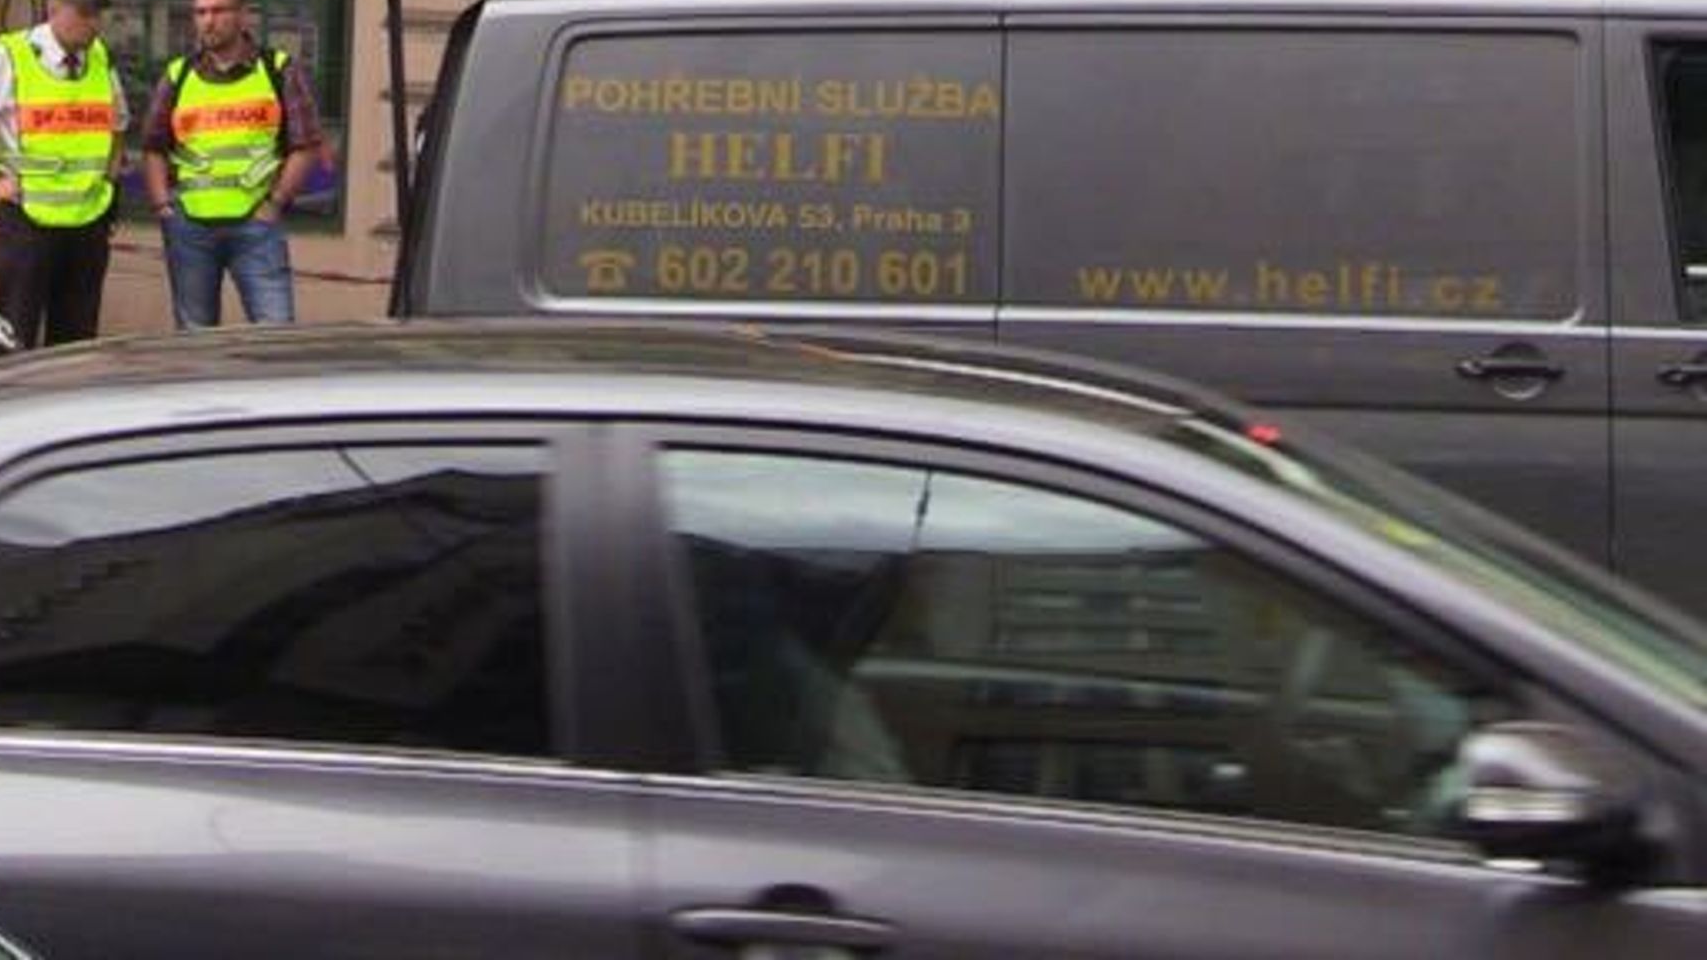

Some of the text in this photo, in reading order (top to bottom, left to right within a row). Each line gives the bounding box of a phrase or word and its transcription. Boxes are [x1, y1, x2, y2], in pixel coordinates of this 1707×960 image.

[561, 71, 1000, 121] POHŘEBNÍ SLUŽBA
[666, 132, 885, 182] HELFI
[853, 204, 942, 232] Praha
[656, 249, 968, 295] 602 210 601
[1077, 260, 1502, 312] www.helfi.cz
